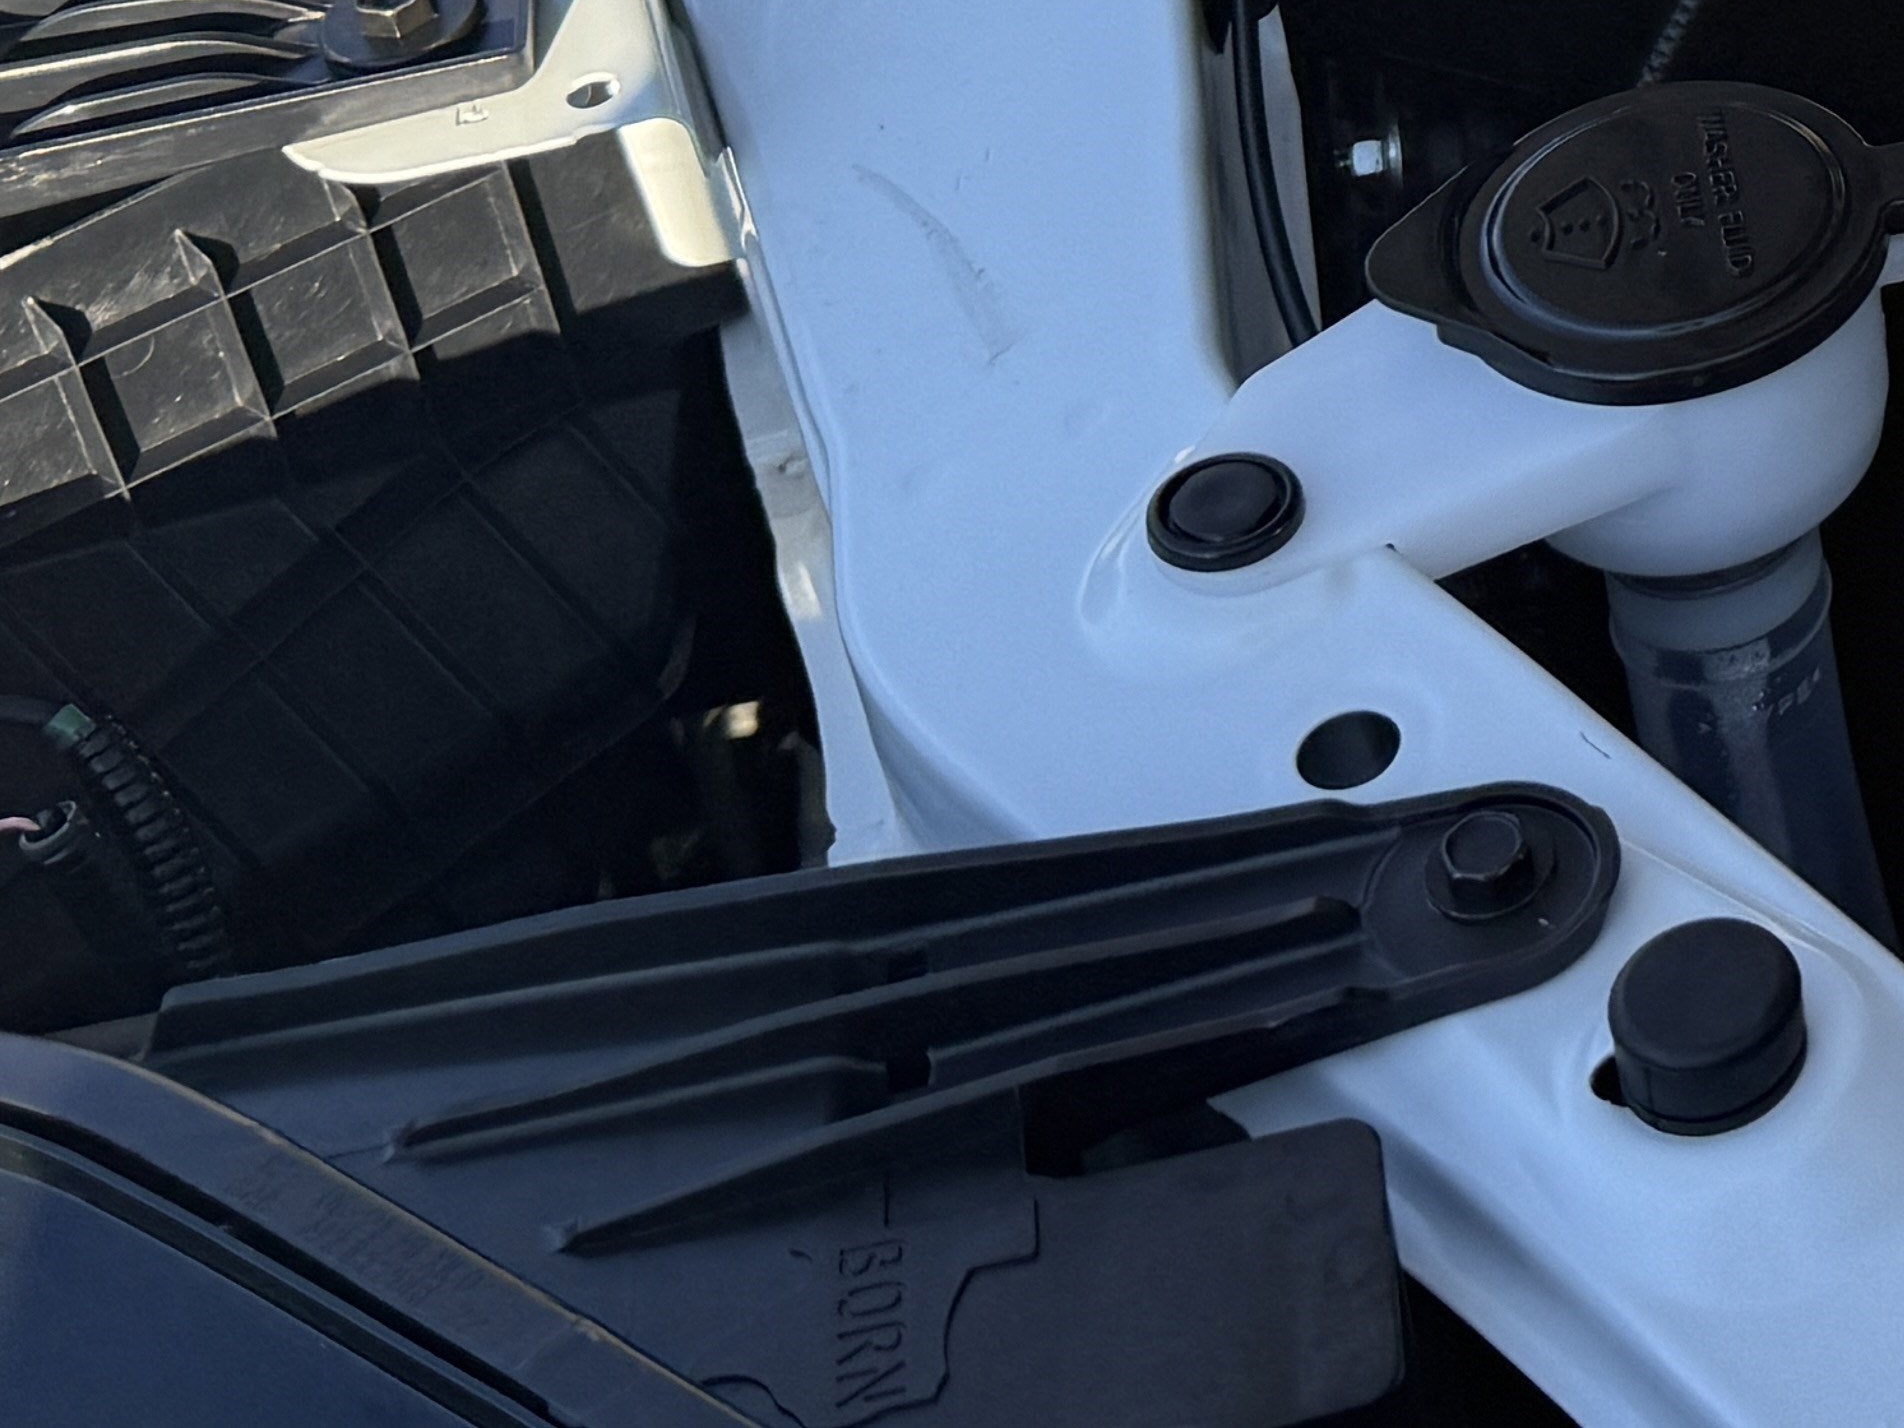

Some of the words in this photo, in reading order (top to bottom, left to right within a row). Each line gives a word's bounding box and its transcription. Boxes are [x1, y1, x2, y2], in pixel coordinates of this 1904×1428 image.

[1670, 170, 1707, 229] ONLY
[1717, 209, 1756, 279] FLUID
[834, 1236, 907, 1410] BORN
